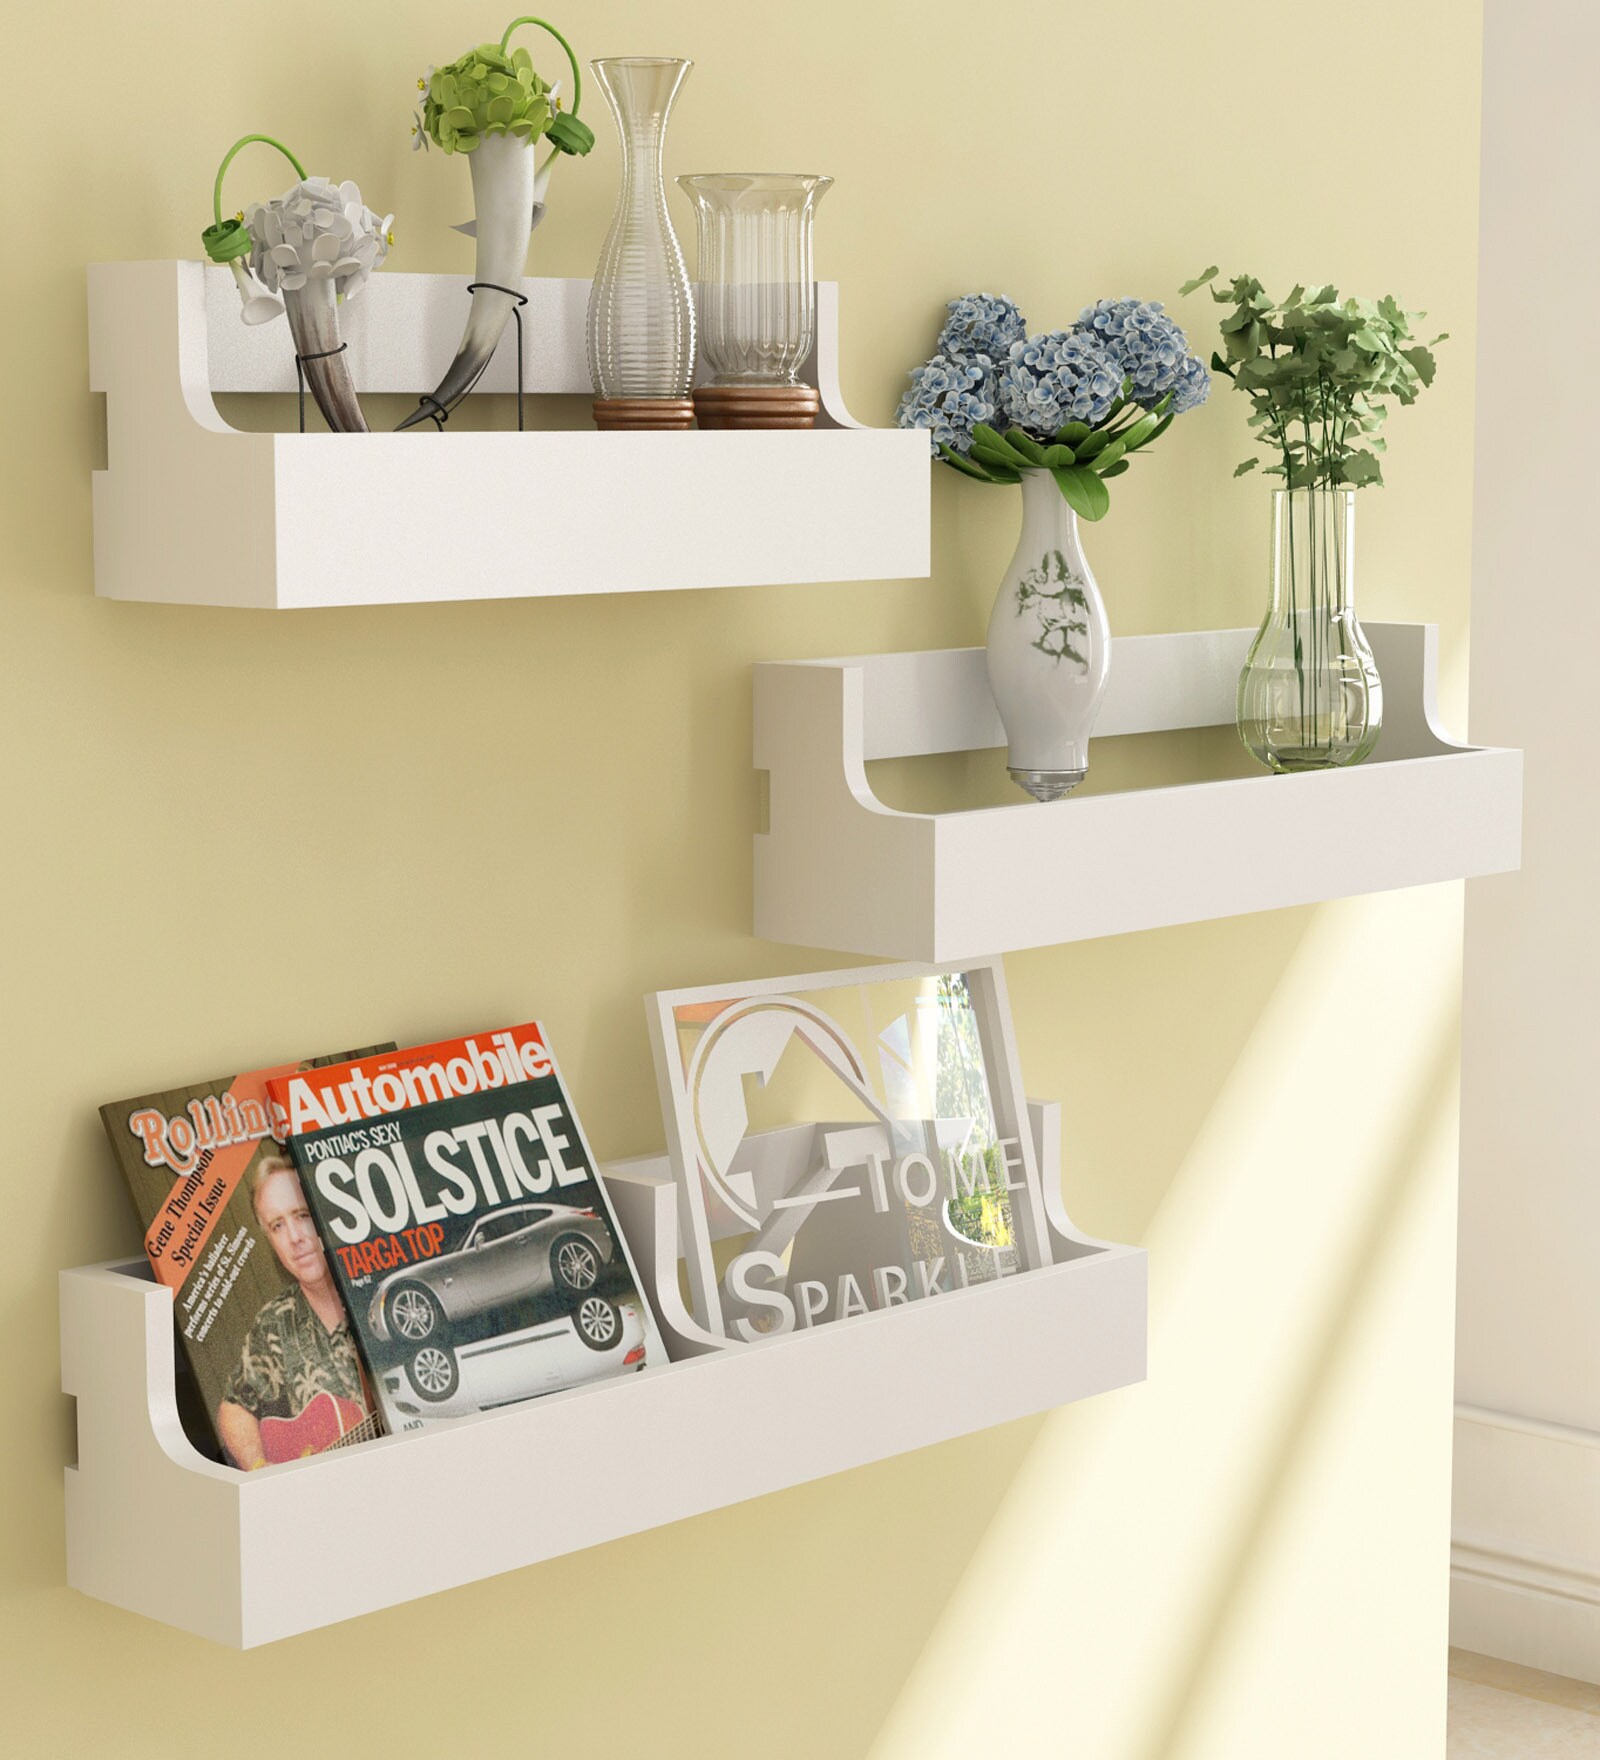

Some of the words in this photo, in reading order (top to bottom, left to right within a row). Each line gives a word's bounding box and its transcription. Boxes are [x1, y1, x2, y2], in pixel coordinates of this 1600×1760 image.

[288, 1032, 552, 1135] Automobile
[304, 1129, 370, 1162] PONTIAC'S
[369, 1121, 402, 1146] SEXY
[315, 1103, 588, 1244] SOLSTICE
[148, 1220, 175, 1258] Gene
[165, 1148, 215, 1219] Thompson
[171, 1211, 208, 1268] Special
[198, 1177, 227, 1216] Issue
[336, 1233, 409, 1279] TARGA
[401, 1222, 445, 1260] TOP
